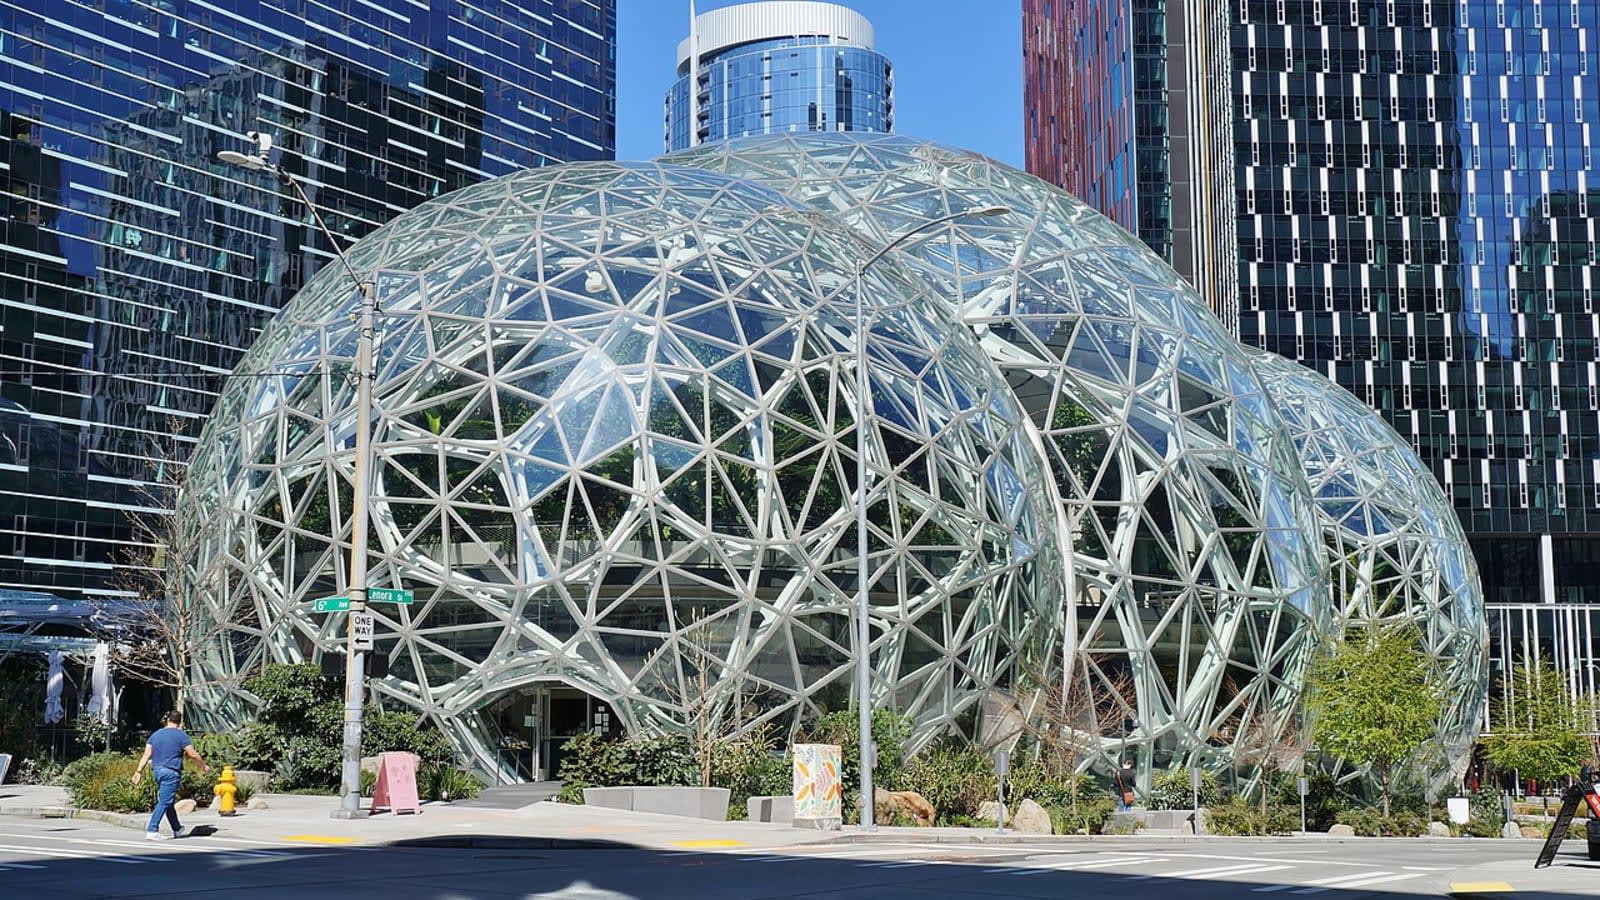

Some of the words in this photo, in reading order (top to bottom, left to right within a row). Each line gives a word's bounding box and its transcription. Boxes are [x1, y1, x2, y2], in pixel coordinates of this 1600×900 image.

[368, 591, 393, 601] Lenora
[354, 615, 371, 626] ONE
[354, 626, 371, 636] WAY
[34, 670, 49, 681] 21
